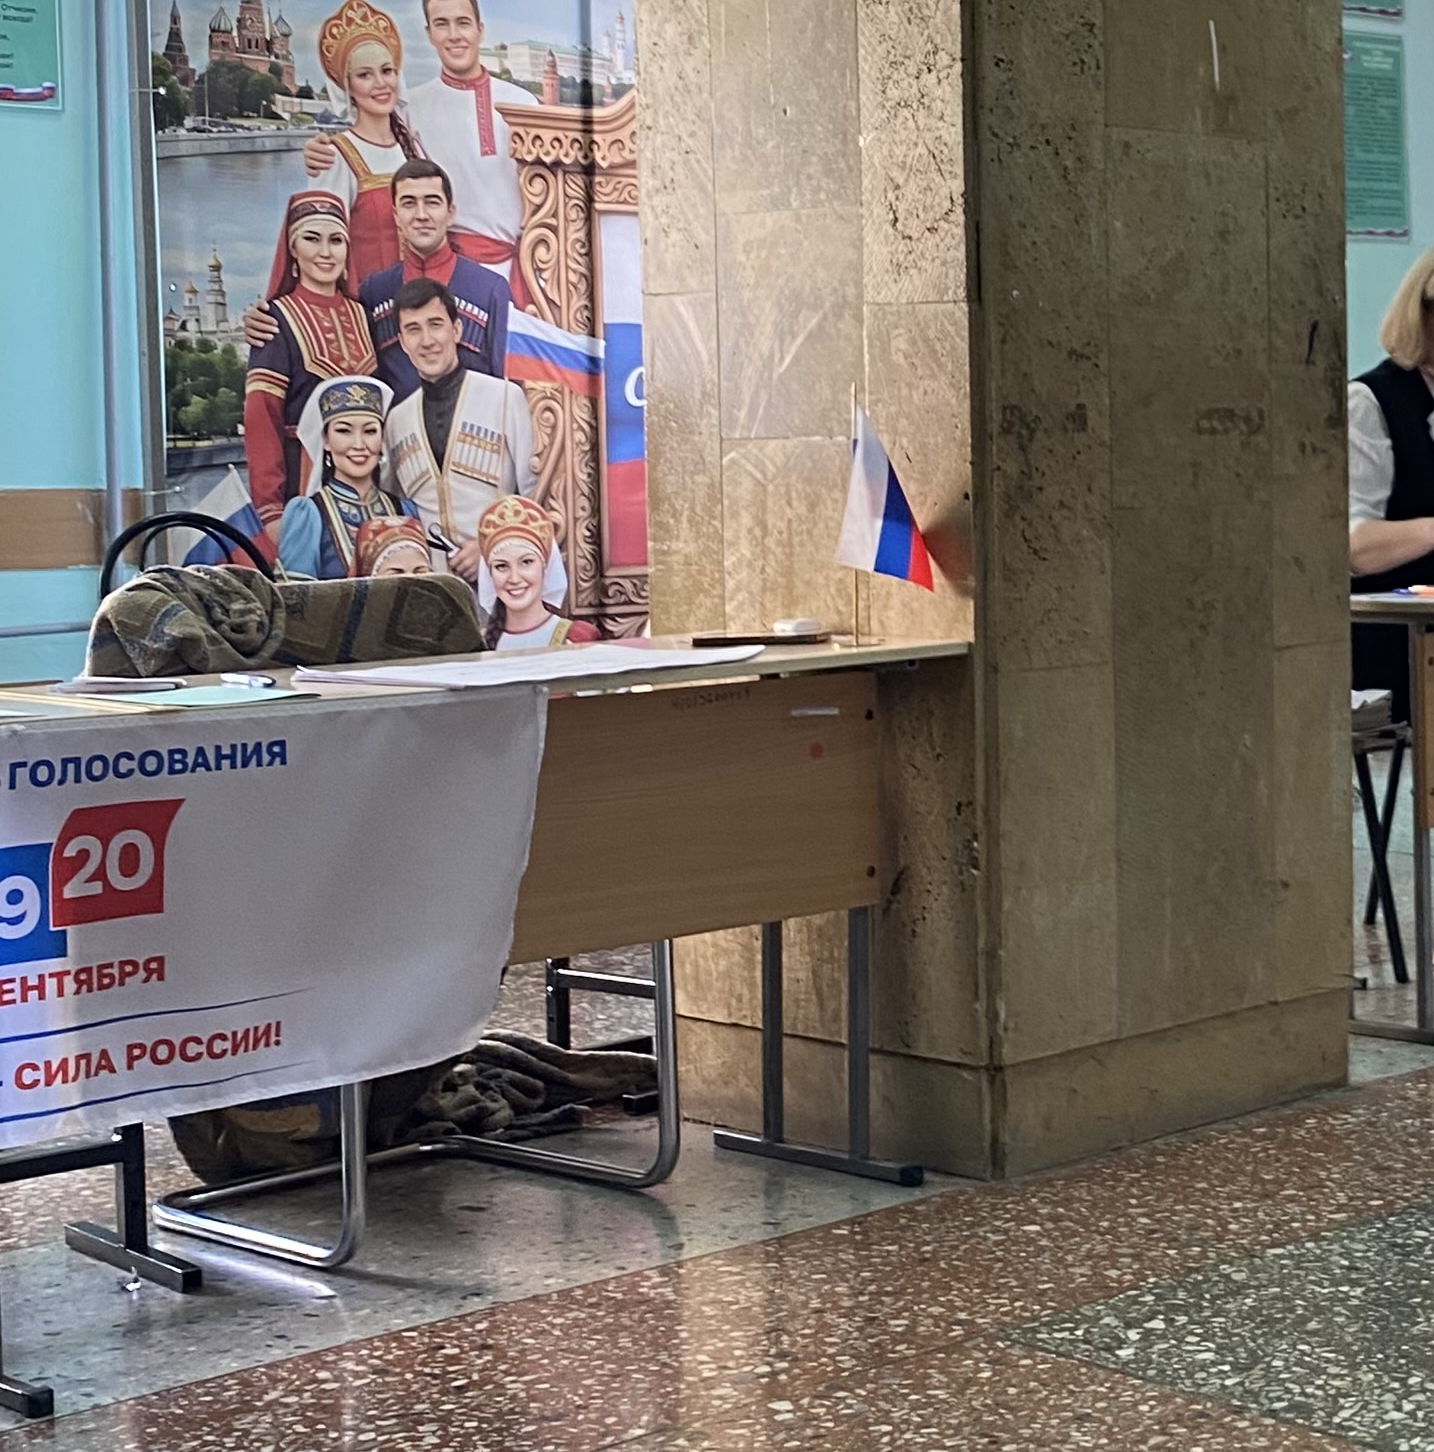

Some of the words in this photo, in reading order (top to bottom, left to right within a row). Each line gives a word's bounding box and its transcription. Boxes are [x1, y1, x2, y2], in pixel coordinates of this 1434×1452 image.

[8, 739, 288, 791] ГОЛОСОВАНИЯ
[62, 828, 156, 901] 20
[14, 1051, 117, 1092] СИЛА
[126, 1021, 282, 1072] РОССИИ!
